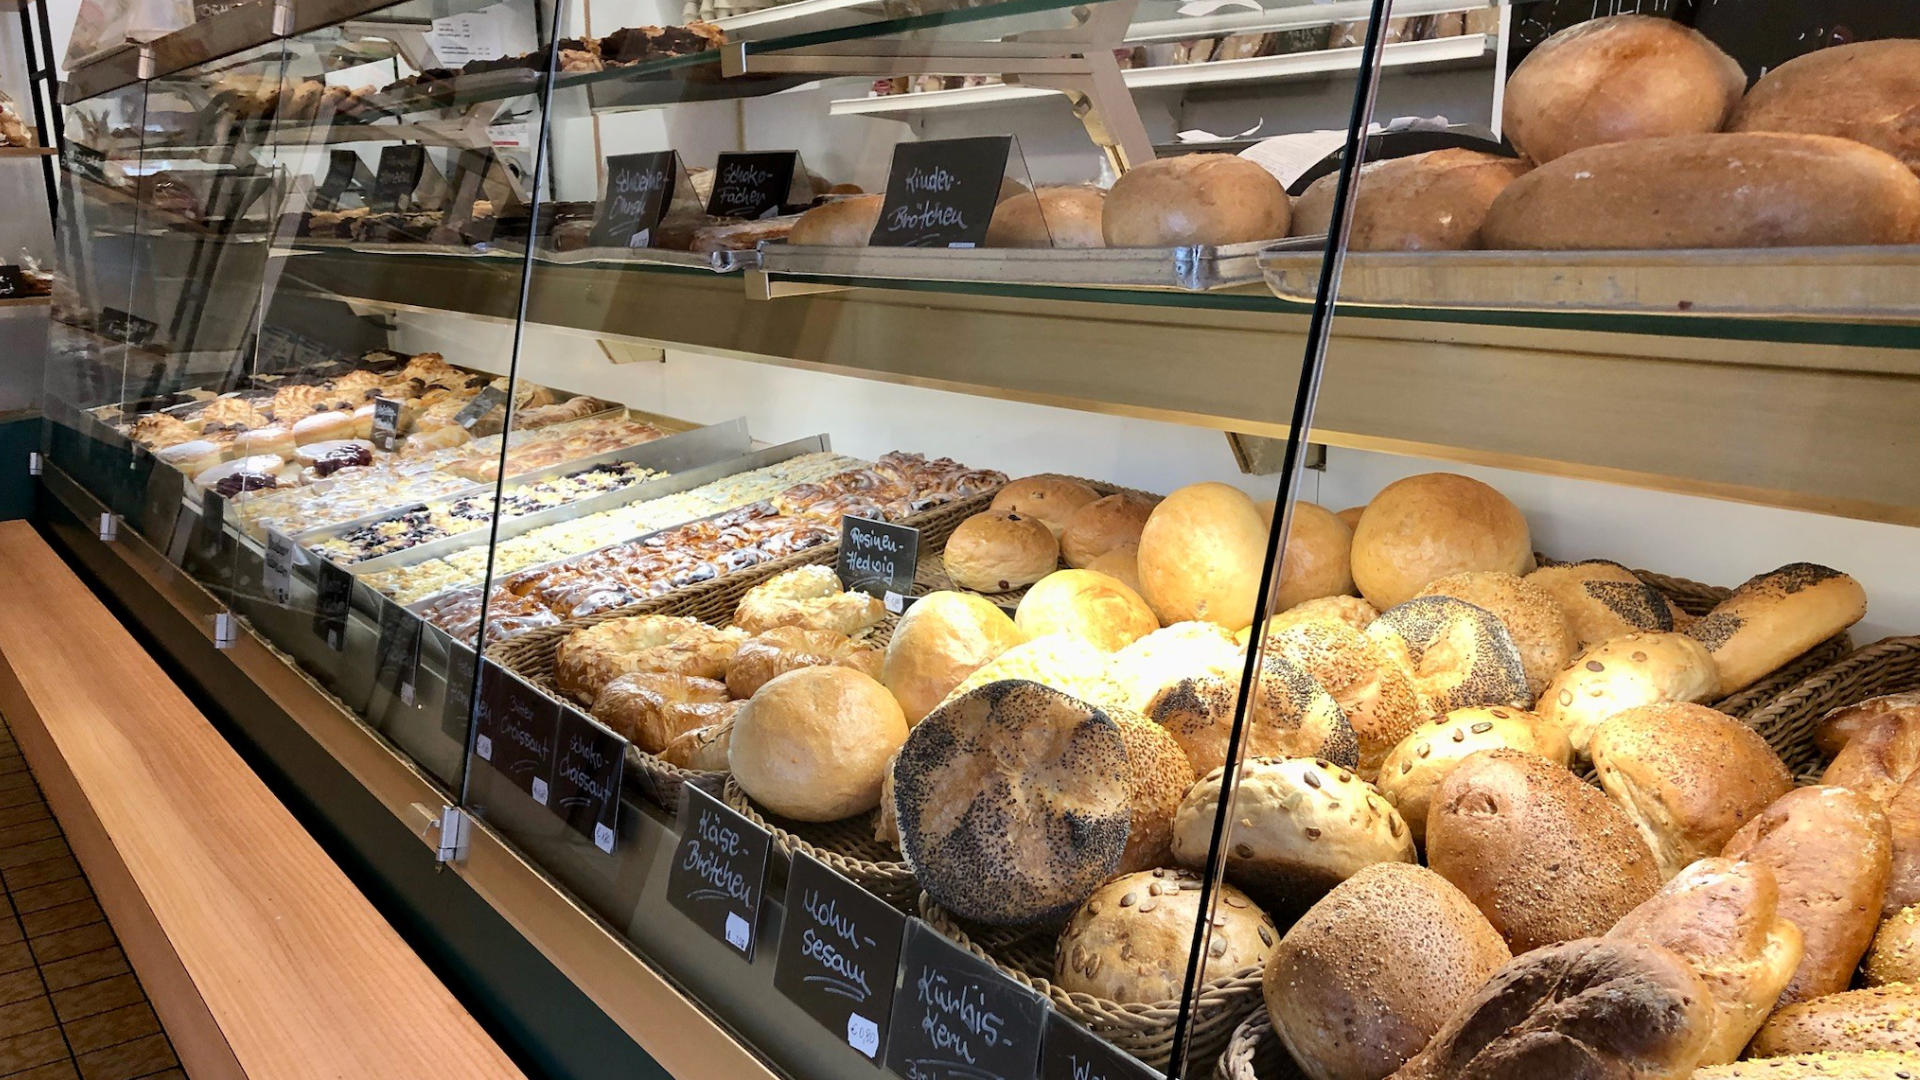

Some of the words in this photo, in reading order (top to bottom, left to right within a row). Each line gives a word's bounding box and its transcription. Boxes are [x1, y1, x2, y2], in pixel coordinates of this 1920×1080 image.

[888, 201, 968, 231] Brötchen
[850, 527, 904, 552] Rosinen-
[846, 551, 894, 586] Hedwig
[559, 756, 613, 804] Croissant
[699, 809, 748, 855] Käse-
[683, 840, 750, 907] Brötchen
[917, 965, 1012, 1047] Kürbis-
